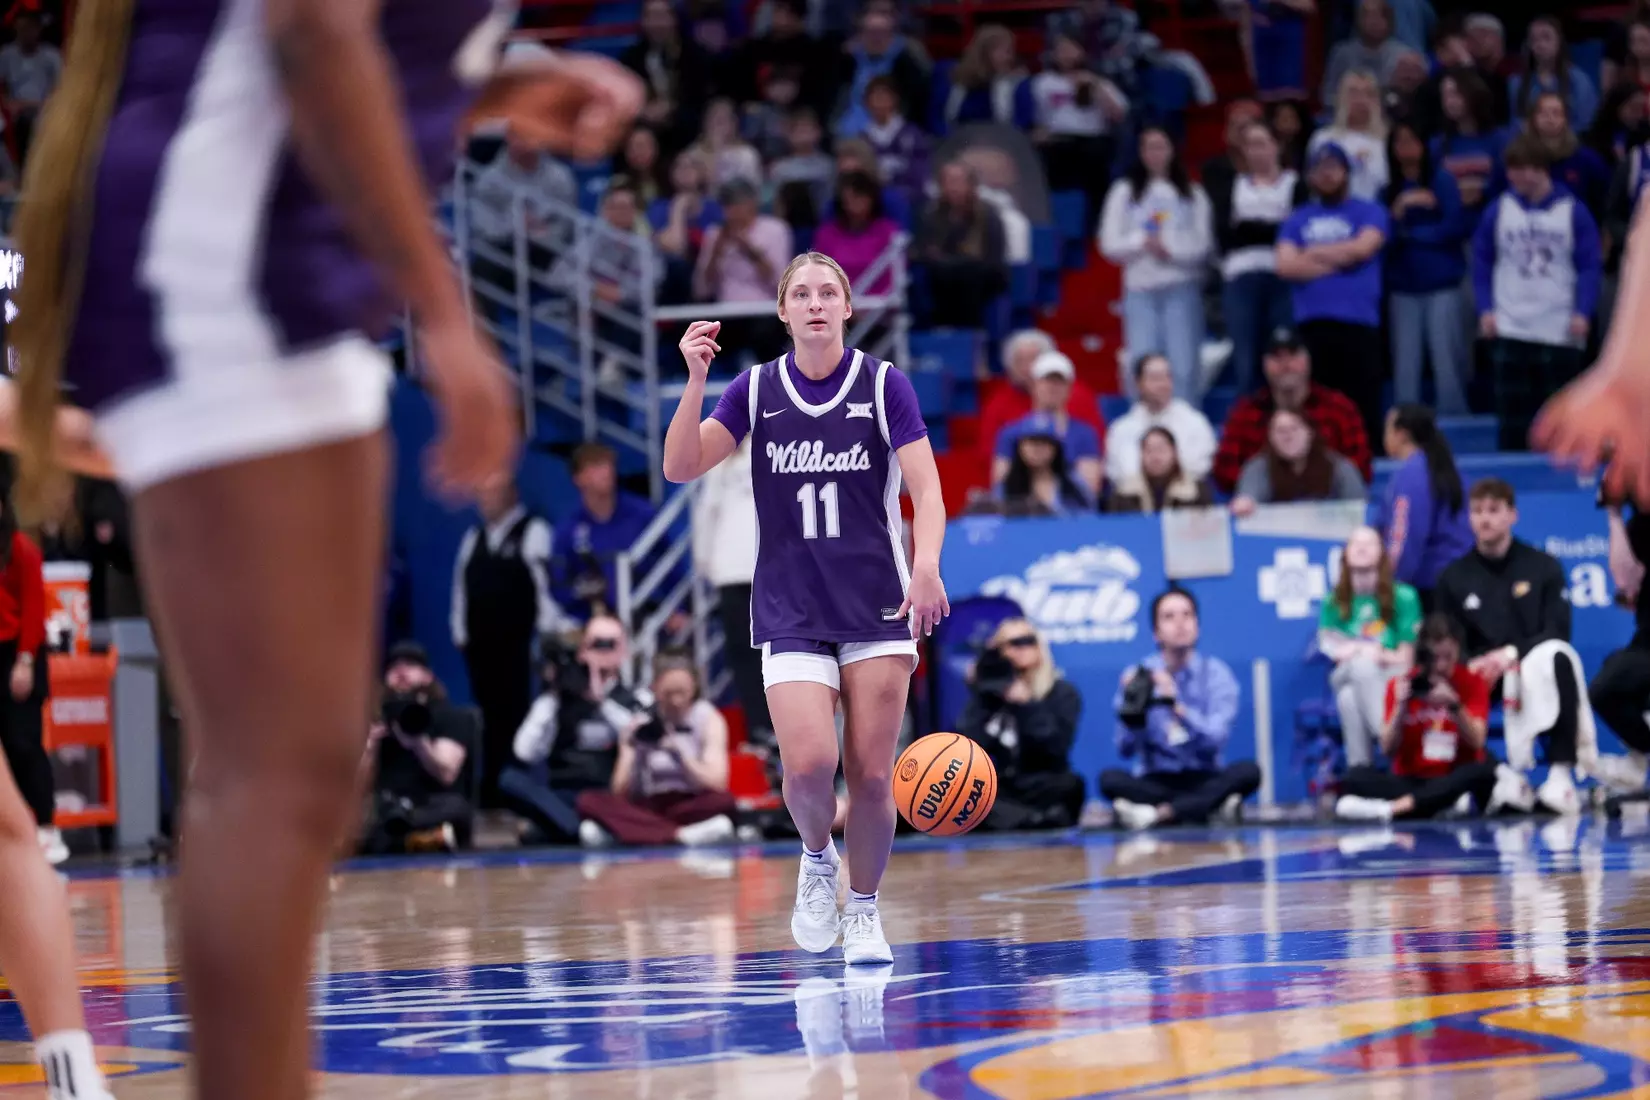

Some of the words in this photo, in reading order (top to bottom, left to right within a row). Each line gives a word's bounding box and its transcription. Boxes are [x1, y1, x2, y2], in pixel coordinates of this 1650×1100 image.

[766, 439, 871, 474] Wildcats
[797, 481, 840, 539] 11
[917, 758, 963, 820] Wilson
[952, 778, 985, 826] NCAA
